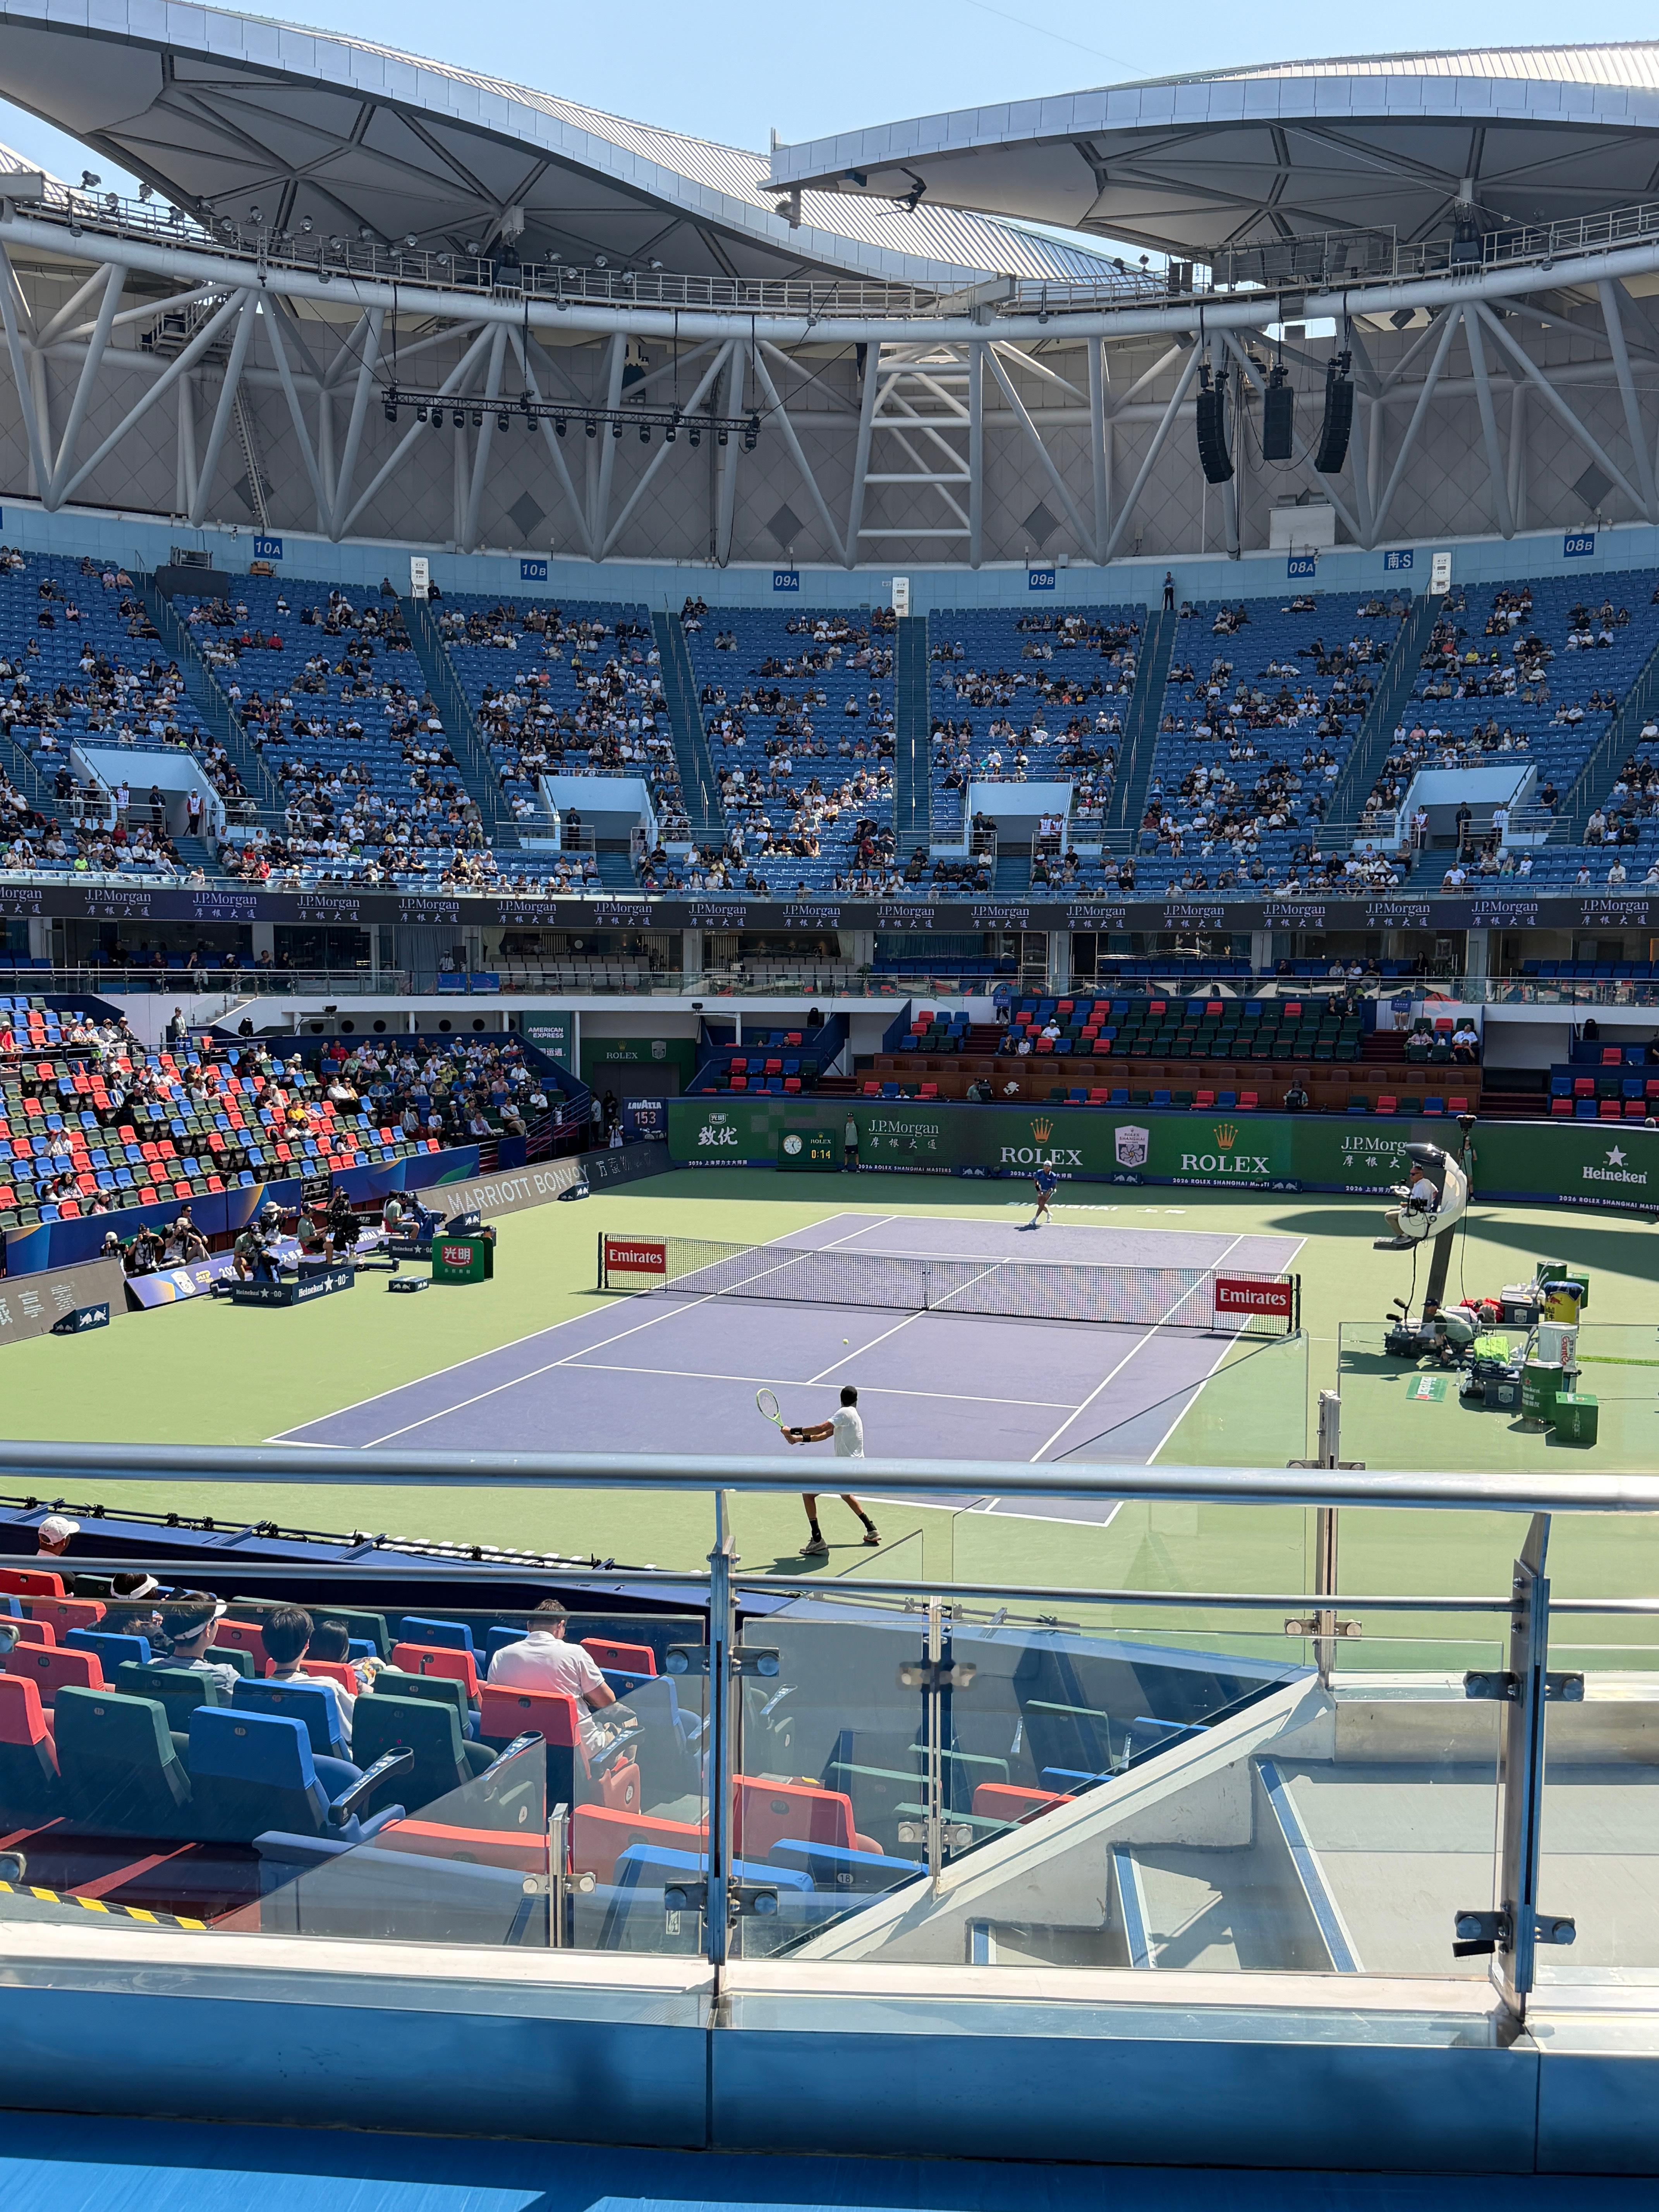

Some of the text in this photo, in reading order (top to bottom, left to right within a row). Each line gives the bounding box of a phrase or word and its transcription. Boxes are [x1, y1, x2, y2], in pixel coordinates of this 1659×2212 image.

[256, 541, 280, 555] 10A
[1566, 539, 1593, 552] 08B
[522, 564, 546, 576] 10B
[1290, 562, 1314, 573] 08A
[775, 575, 798, 586] 09A
[1031, 574, 1054, 585] 09B
[85, 888, 152, 905] J.P.Morgan
[193, 893, 257, 908] J.P.Morgan
[297, 895, 360, 910] J.P.Morgan
[87, 905, 150, 916] 摩根大通
[399, 898, 459, 913] J.P.Morgan
[497, 899, 557, 915] J.P.Morgan
[594, 903, 652, 916] J.P.Morgan
[689, 904, 746, 917] J.P.Morgan
[783, 905, 840, 918] J.P.Morgan
[1163, 905, 1224, 919] J.P.Morgan
[1263, 904, 1325, 917] J.P.Morgan
[1365, 903, 1430, 917] J.P.Morgan
[1472, 901, 1538, 915] J.P.Morgan
[1580, 900, 1649, 914] J.P.Morgan
[195, 908, 256, 919] 摩根大通
[299, 911, 358, 921] 摩根大通
[400, 912, 458, 922] 摩根大通
[499, 914, 555, 924] 摩根大通
[877, 906, 934, 919] J.P.Morgan
[971, 906, 1029, 919] J.P.Morgan
[1066, 906, 1125, 919] J.P.Morgan
[596, 916, 651, 925] 摩根大通
[690, 917, 745, 927] 摩根大通
[784, 918, 838, 927] 摩根大通
[878, 919, 933, 928] 摩根大通
[972, 919, 1027, 928] 摩根大通
[1068, 919, 1123, 929] 摩根大通
[1164, 919, 1222, 928] 摩根大通
[1264, 918, 1323, 928] 摩根大通
[1367, 917, 1427, 927] 摩根大通
[1473, 916, 1535, 926] 摩根大通
[1582, 915, 1646, 925] 摩根大通
[628, 1100, 661, 1109] LAVAZZA
[635, 1111, 656, 1124] 153
[698, 1125, 738, 1145] 致优
[869, 1120, 939, 1137] J.P.Morgan
[870, 1137, 937, 1149] 摩根大通
[811, 1150, 830, 1159] 0:14
[1000, 1147, 1083, 1166] ROLEX
[1181, 1154, 1270, 1173] ROLEX
[1583, 1166, 1647, 1183] Heineken
[447, 1164, 589, 1214] MARRIOTT BONVOY
[1602, 1199, 1637, 1208] SHANGHAI
[445, 1247, 471, 1260] 光明
[610, 1249, 662, 1264] Emirates
[299, 1281, 324, 1297] Heineken
[1220, 1288, 1286, 1305] Emirates
[842, 1874, 852, 1882] 18
